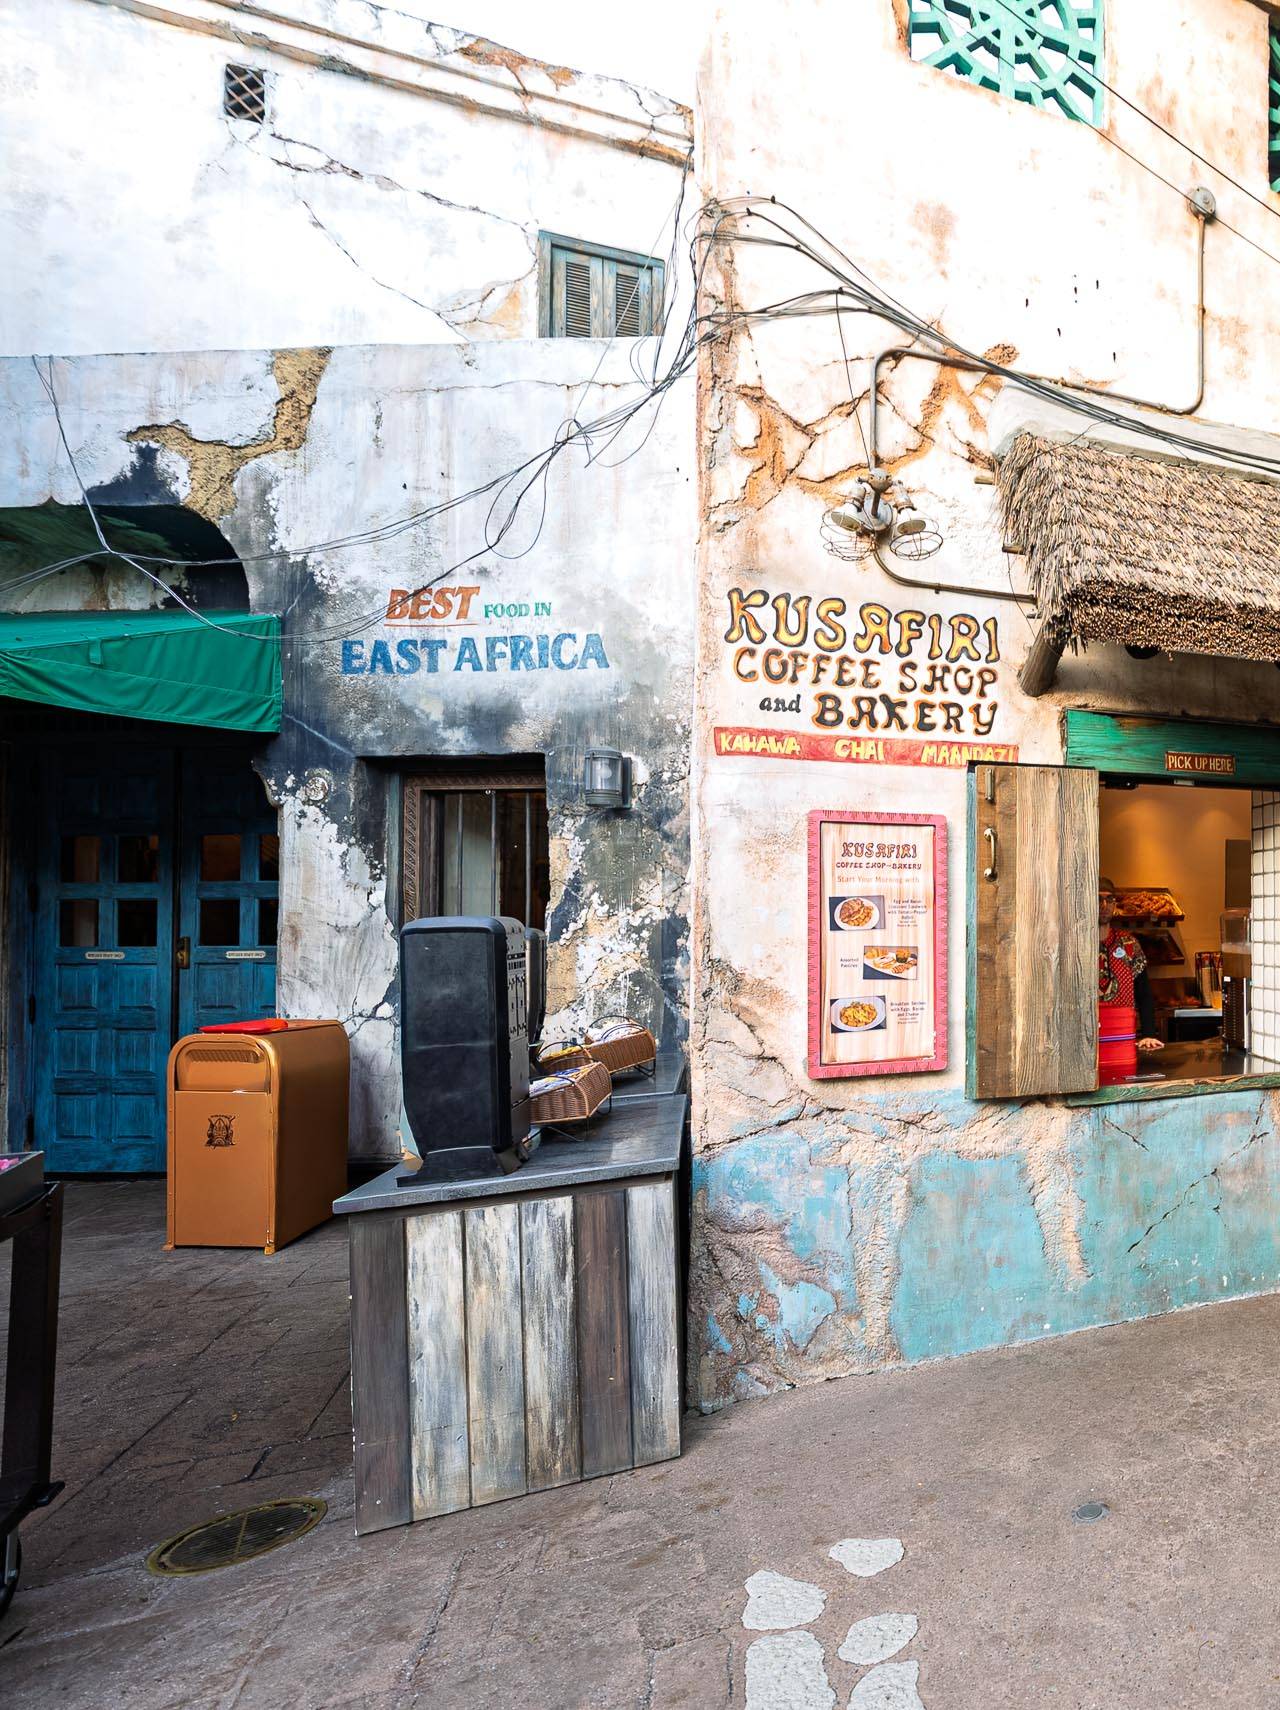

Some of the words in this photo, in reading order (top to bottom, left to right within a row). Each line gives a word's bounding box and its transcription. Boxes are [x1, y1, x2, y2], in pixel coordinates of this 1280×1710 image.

[385, 586, 481, 621] BEST
[484, 602, 530, 619] FOOD
[534, 602, 552, 617] IN
[724, 587, 1000, 664] KUSAFIRI
[340, 638, 448, 676] EAST
[453, 632, 610, 673] AFRICA
[733, 646, 882, 690] COFFEE
[898, 660, 999, 699] SHOP
[758, 694, 801, 714] and
[811, 692, 998, 736] BAKERY
[719, 733, 800, 756] KAHAWA
[833, 739, 885, 762] CHAI
[1167, 755, 1193, 770] PICK
[1194, 756, 1208, 770] UP
[1209, 757, 1234, 772] HERE
[836, 861, 864, 869] COFFEE
[841, 841, 918, 859] KUSAFIRI
